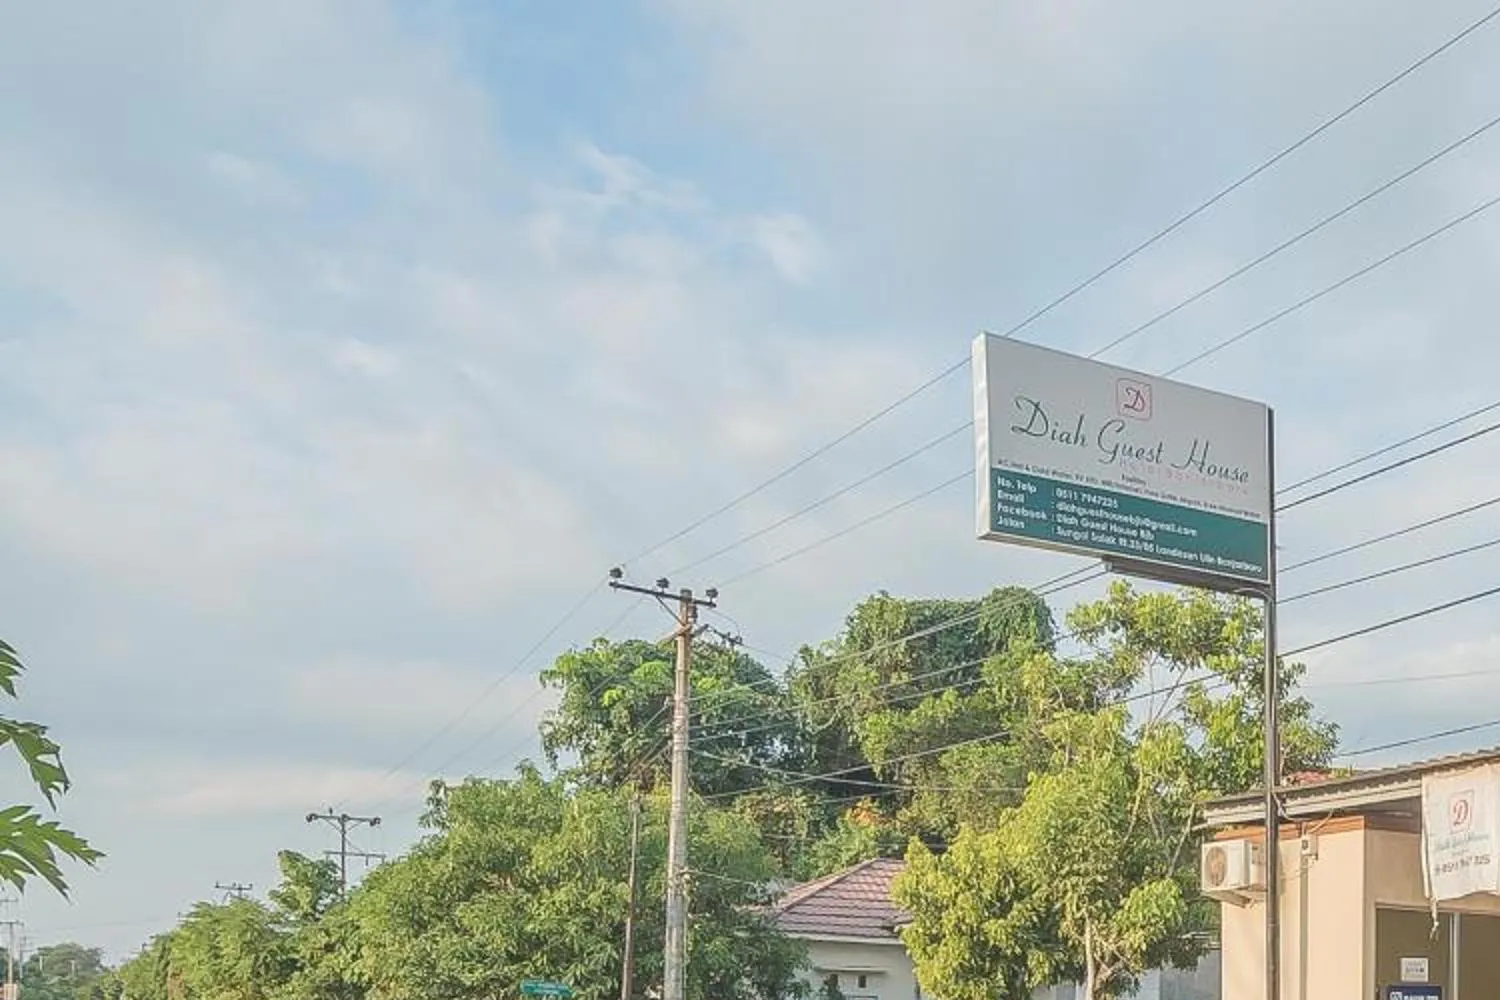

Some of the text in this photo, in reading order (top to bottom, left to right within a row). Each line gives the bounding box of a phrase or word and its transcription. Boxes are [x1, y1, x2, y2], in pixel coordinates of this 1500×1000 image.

[1011, 396, 1088, 447] Diah
[1097, 419, 1164, 464] Guest
[1171, 438, 1248, 481] House
